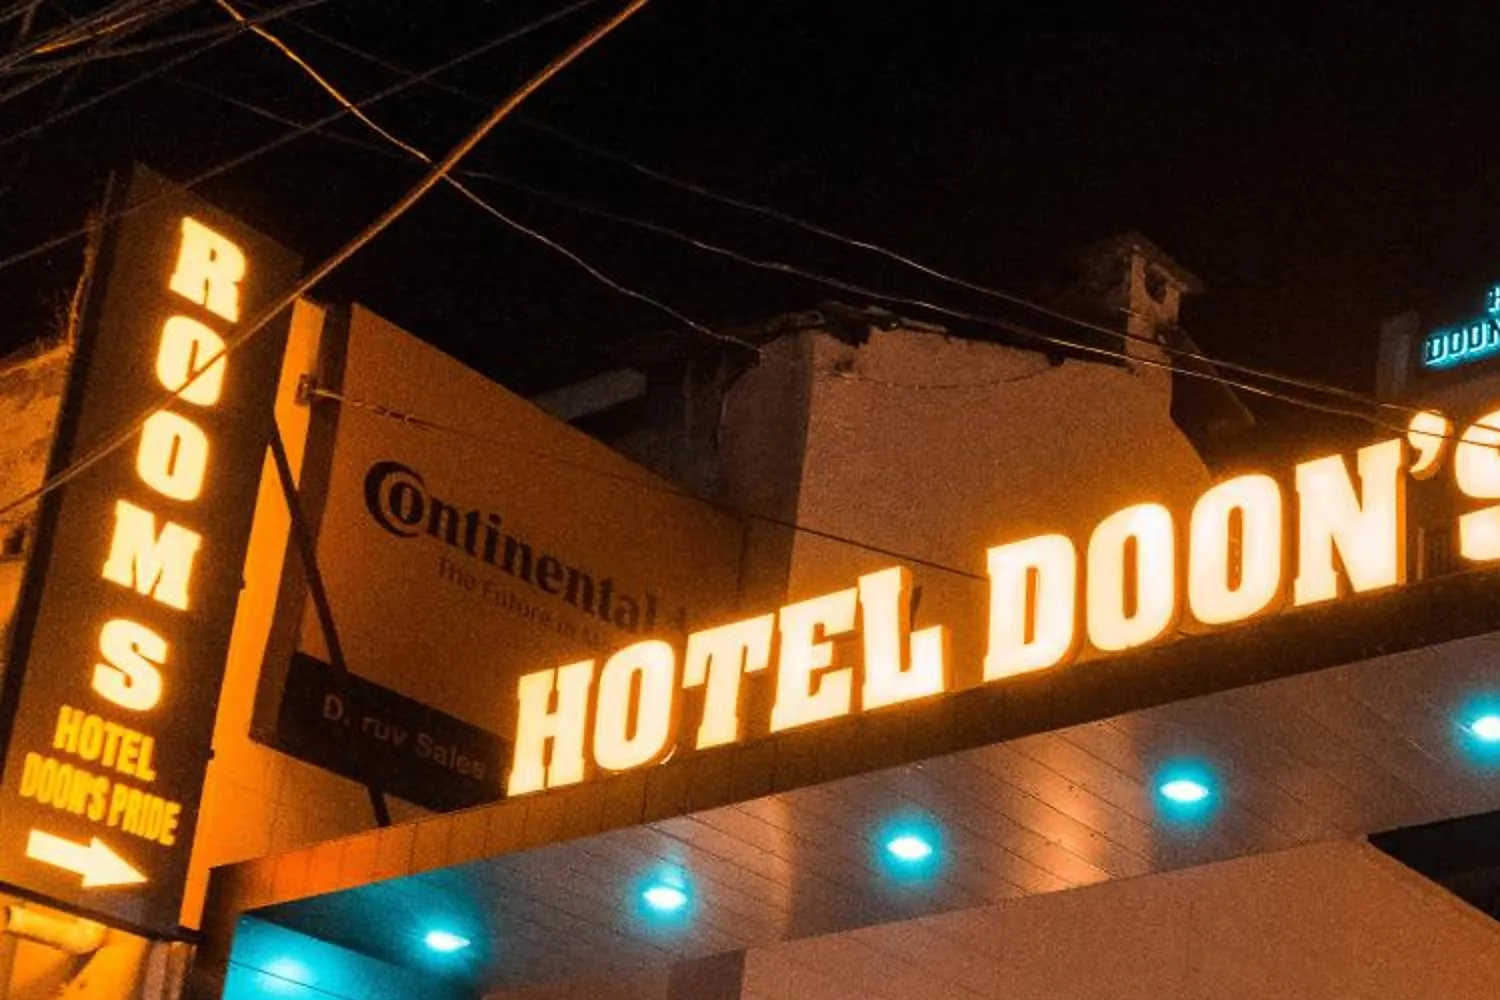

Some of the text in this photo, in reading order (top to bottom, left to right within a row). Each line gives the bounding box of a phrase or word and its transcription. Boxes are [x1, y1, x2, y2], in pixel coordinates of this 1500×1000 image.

[92, 215, 249, 712] ROOMS
[363, 459, 658, 634] Continental
[438, 555, 477, 592] The
[507, 565, 950, 799] HOTEL
[53, 705, 157, 782] HOTEL
[414, 731, 487, 781] Sales
[19, 751, 182, 847] DOON'S PRIDE
